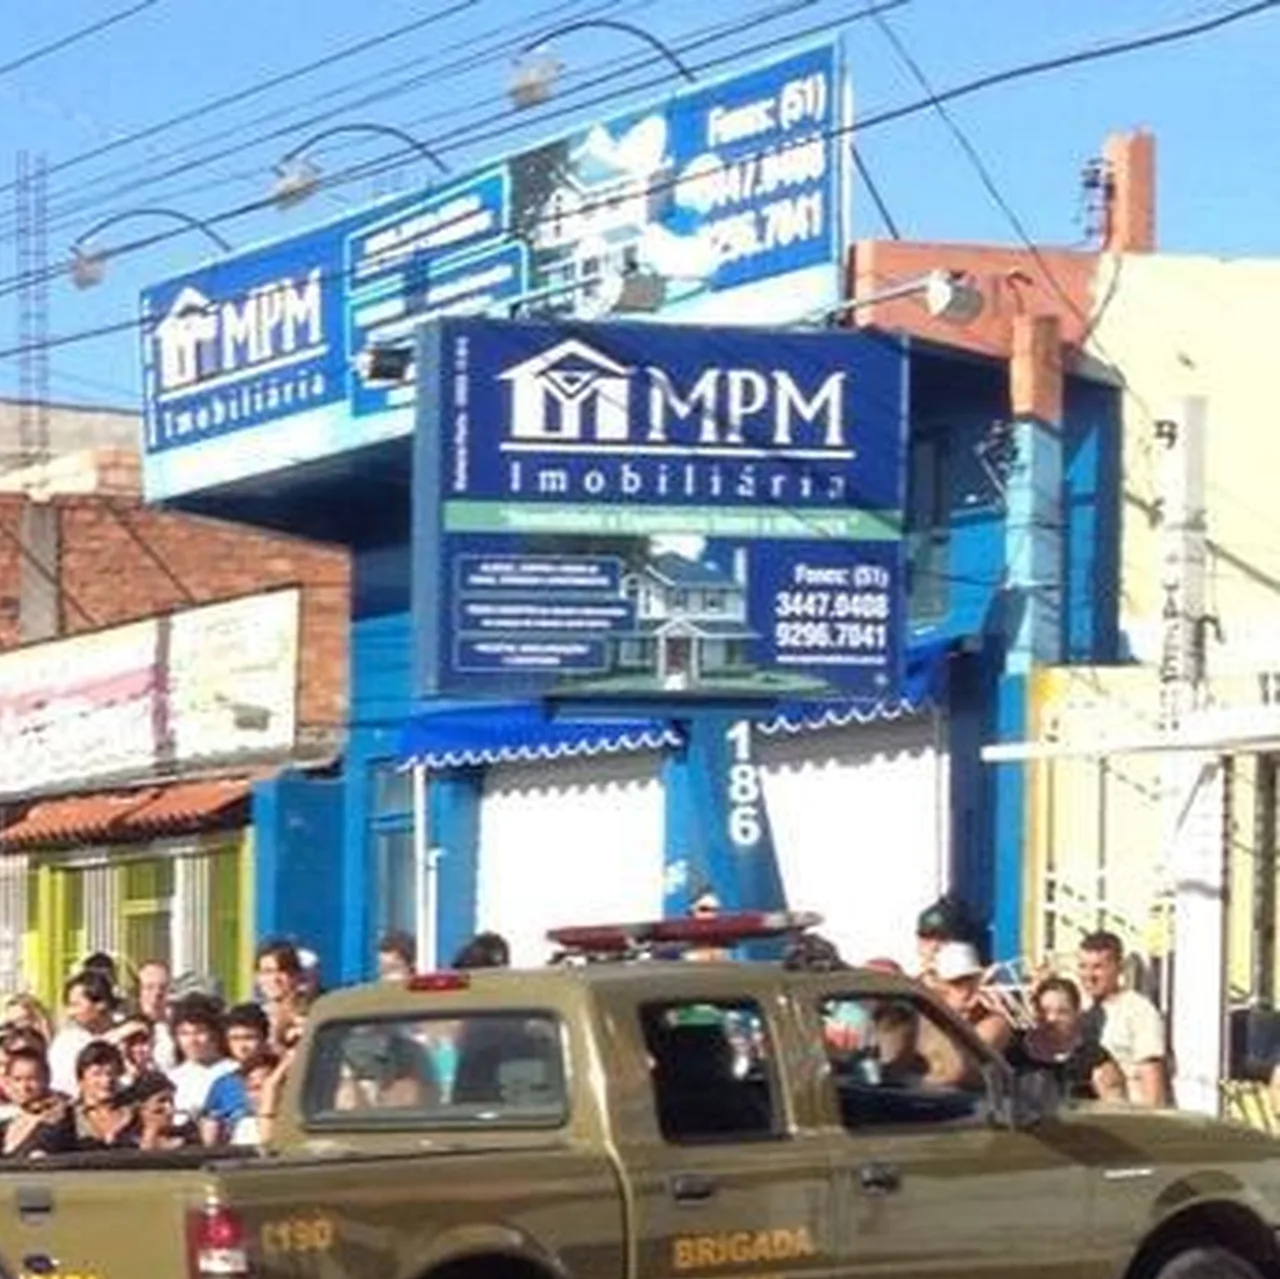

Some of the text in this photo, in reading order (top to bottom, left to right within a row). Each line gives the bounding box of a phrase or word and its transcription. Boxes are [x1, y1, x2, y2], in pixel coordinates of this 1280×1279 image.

[222, 266, 322, 370] MPM
[646, 365, 847, 445] MPM
[509, 461, 846, 498] Imobiliária
[725, 719, 762, 846] 186
[673, 1226, 815, 1270] BRIGADA
